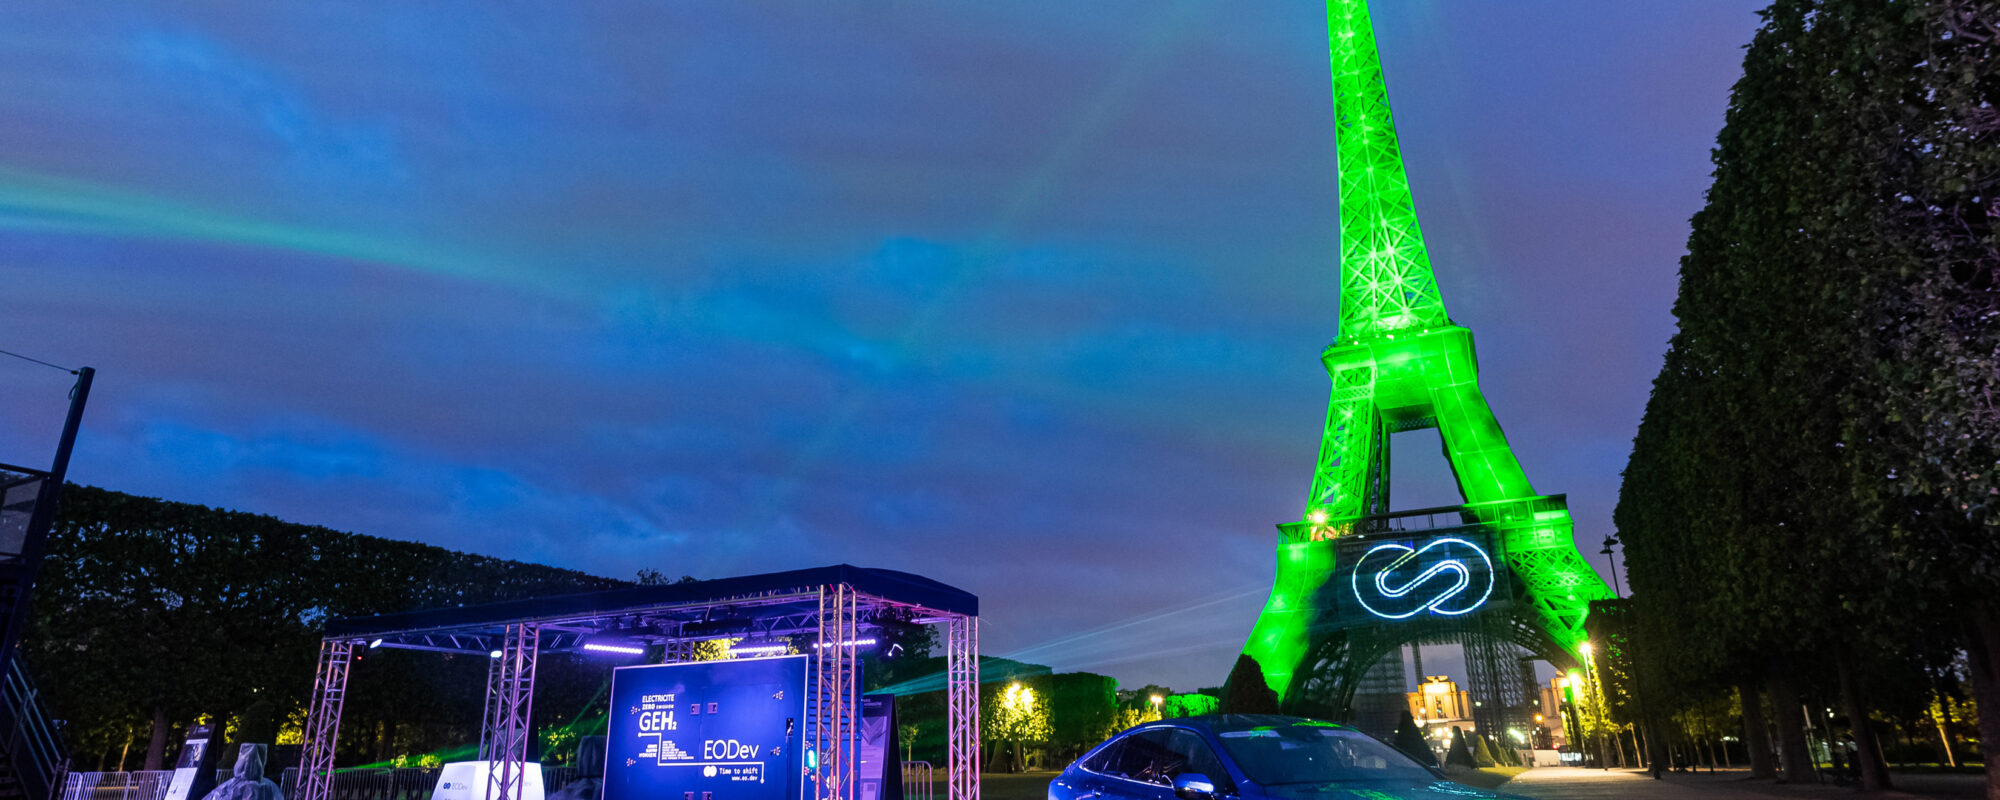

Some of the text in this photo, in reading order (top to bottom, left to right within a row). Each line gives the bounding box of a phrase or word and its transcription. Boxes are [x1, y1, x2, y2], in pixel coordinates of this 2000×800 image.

[642, 694, 675, 703] ELECTRICITE
[704, 739, 759, 760] EODev
[719, 767, 732, 775] Time
[742, 766, 758, 775] shift
